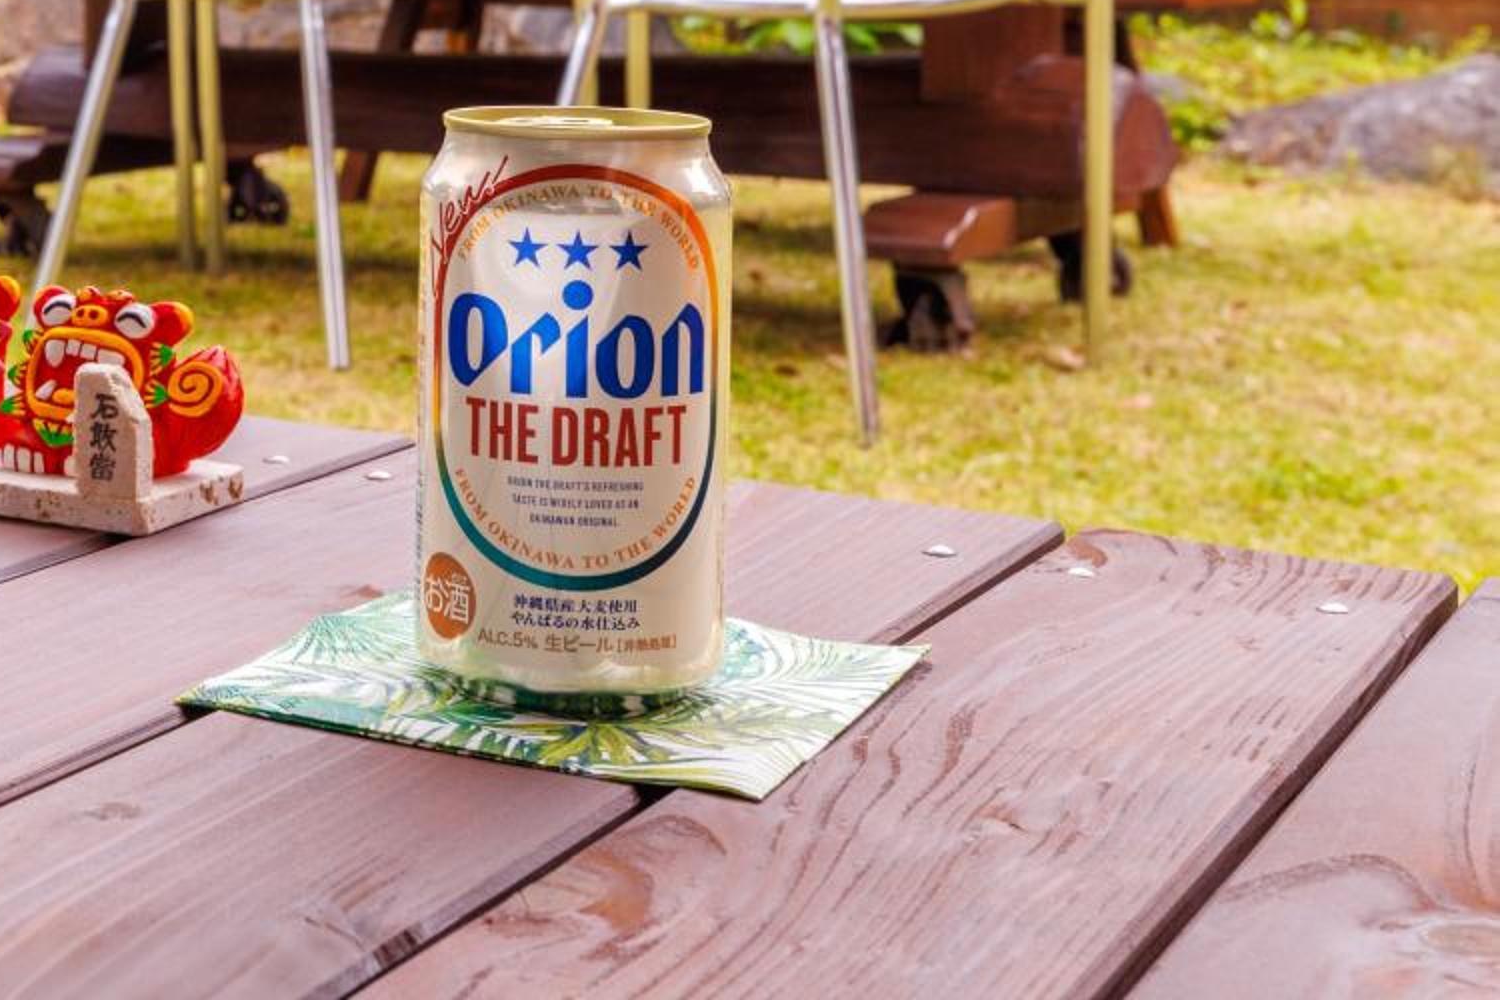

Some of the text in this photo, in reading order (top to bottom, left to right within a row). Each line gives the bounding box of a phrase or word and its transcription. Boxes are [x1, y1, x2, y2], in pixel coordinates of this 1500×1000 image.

[492, 183, 580, 218] OKINAWA
[659, 209, 699, 272] WORLD
[448, 280, 704, 399] Orion
[466, 396, 687, 468] THE DRAFT
[455, 467, 696, 569] FROM OKINAWA TO THE WORLD
[426, 573, 471, 625] お酒
[512, 611, 641, 631] やんばるの水仕込み
[544, 633, 613, 653] 生ビール
